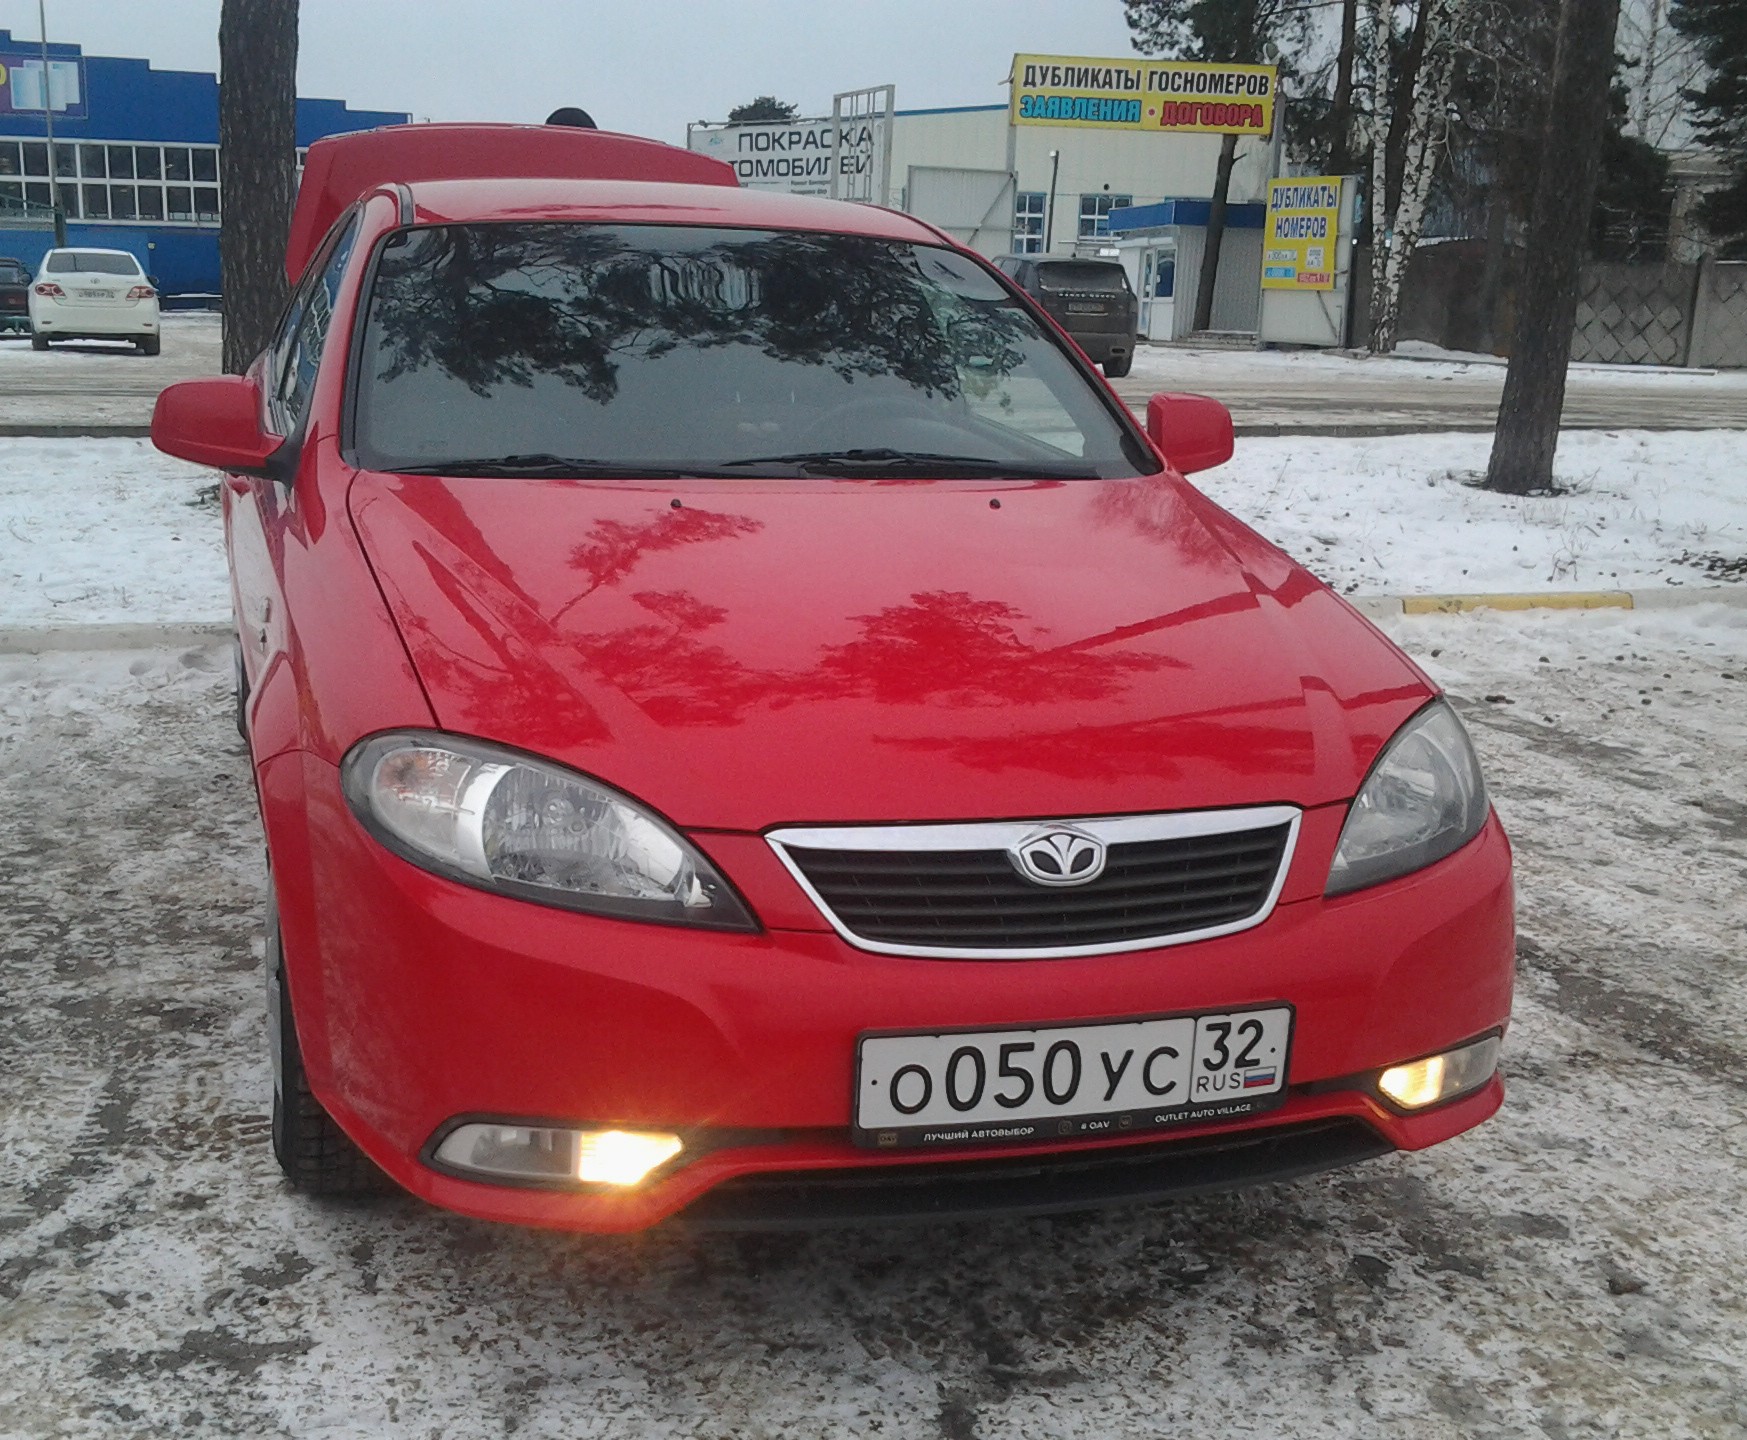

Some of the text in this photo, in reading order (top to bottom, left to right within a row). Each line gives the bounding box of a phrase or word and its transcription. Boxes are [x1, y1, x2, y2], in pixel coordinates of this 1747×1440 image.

[1022, 64, 1269, 96] ДУБЛИКАТЫ ГОСНОМЕРОВ
[1019, 95, 1264, 127] ЗАЯВЛЕНИЯ ДОГОВОРА
[738, 126, 874, 152] ПОКРАСКА
[1270, 185, 1338, 212] ДУБЛИКАТЫ
[1275, 217, 1328, 239] НОМЕРОВ
[1202, 1020, 1264, 1071] 32
[1196, 1071, 1241, 1093] RUS
[1154, 1103, 1252, 1123] OUTLET AUTO VILLAGE
[923, 1126, 1035, 1142] ЛУЧШИЙ АВТОВЫБОР
